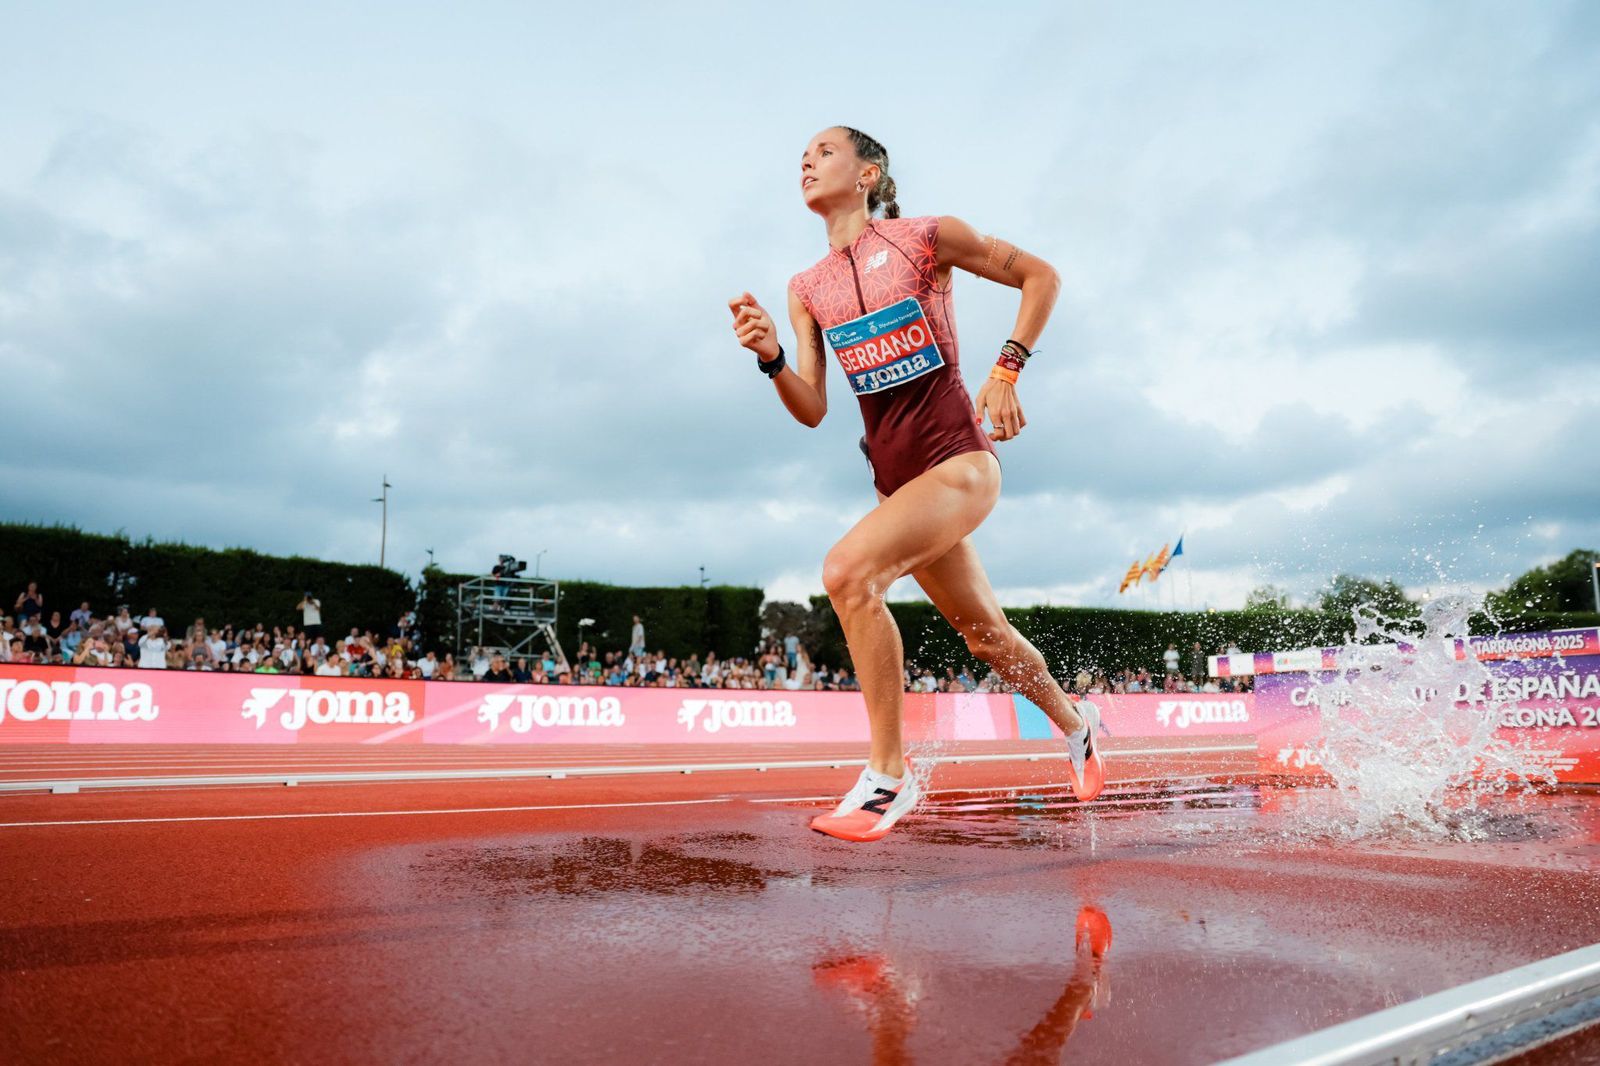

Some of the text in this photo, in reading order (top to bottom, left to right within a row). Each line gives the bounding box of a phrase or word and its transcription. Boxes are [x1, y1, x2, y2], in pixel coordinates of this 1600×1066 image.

[838, 325, 926, 372] SERRANO
[1473, 634, 1585, 655] TARRAGONA 2025
[1491, 671, 1600, 700] ESPAÑA
